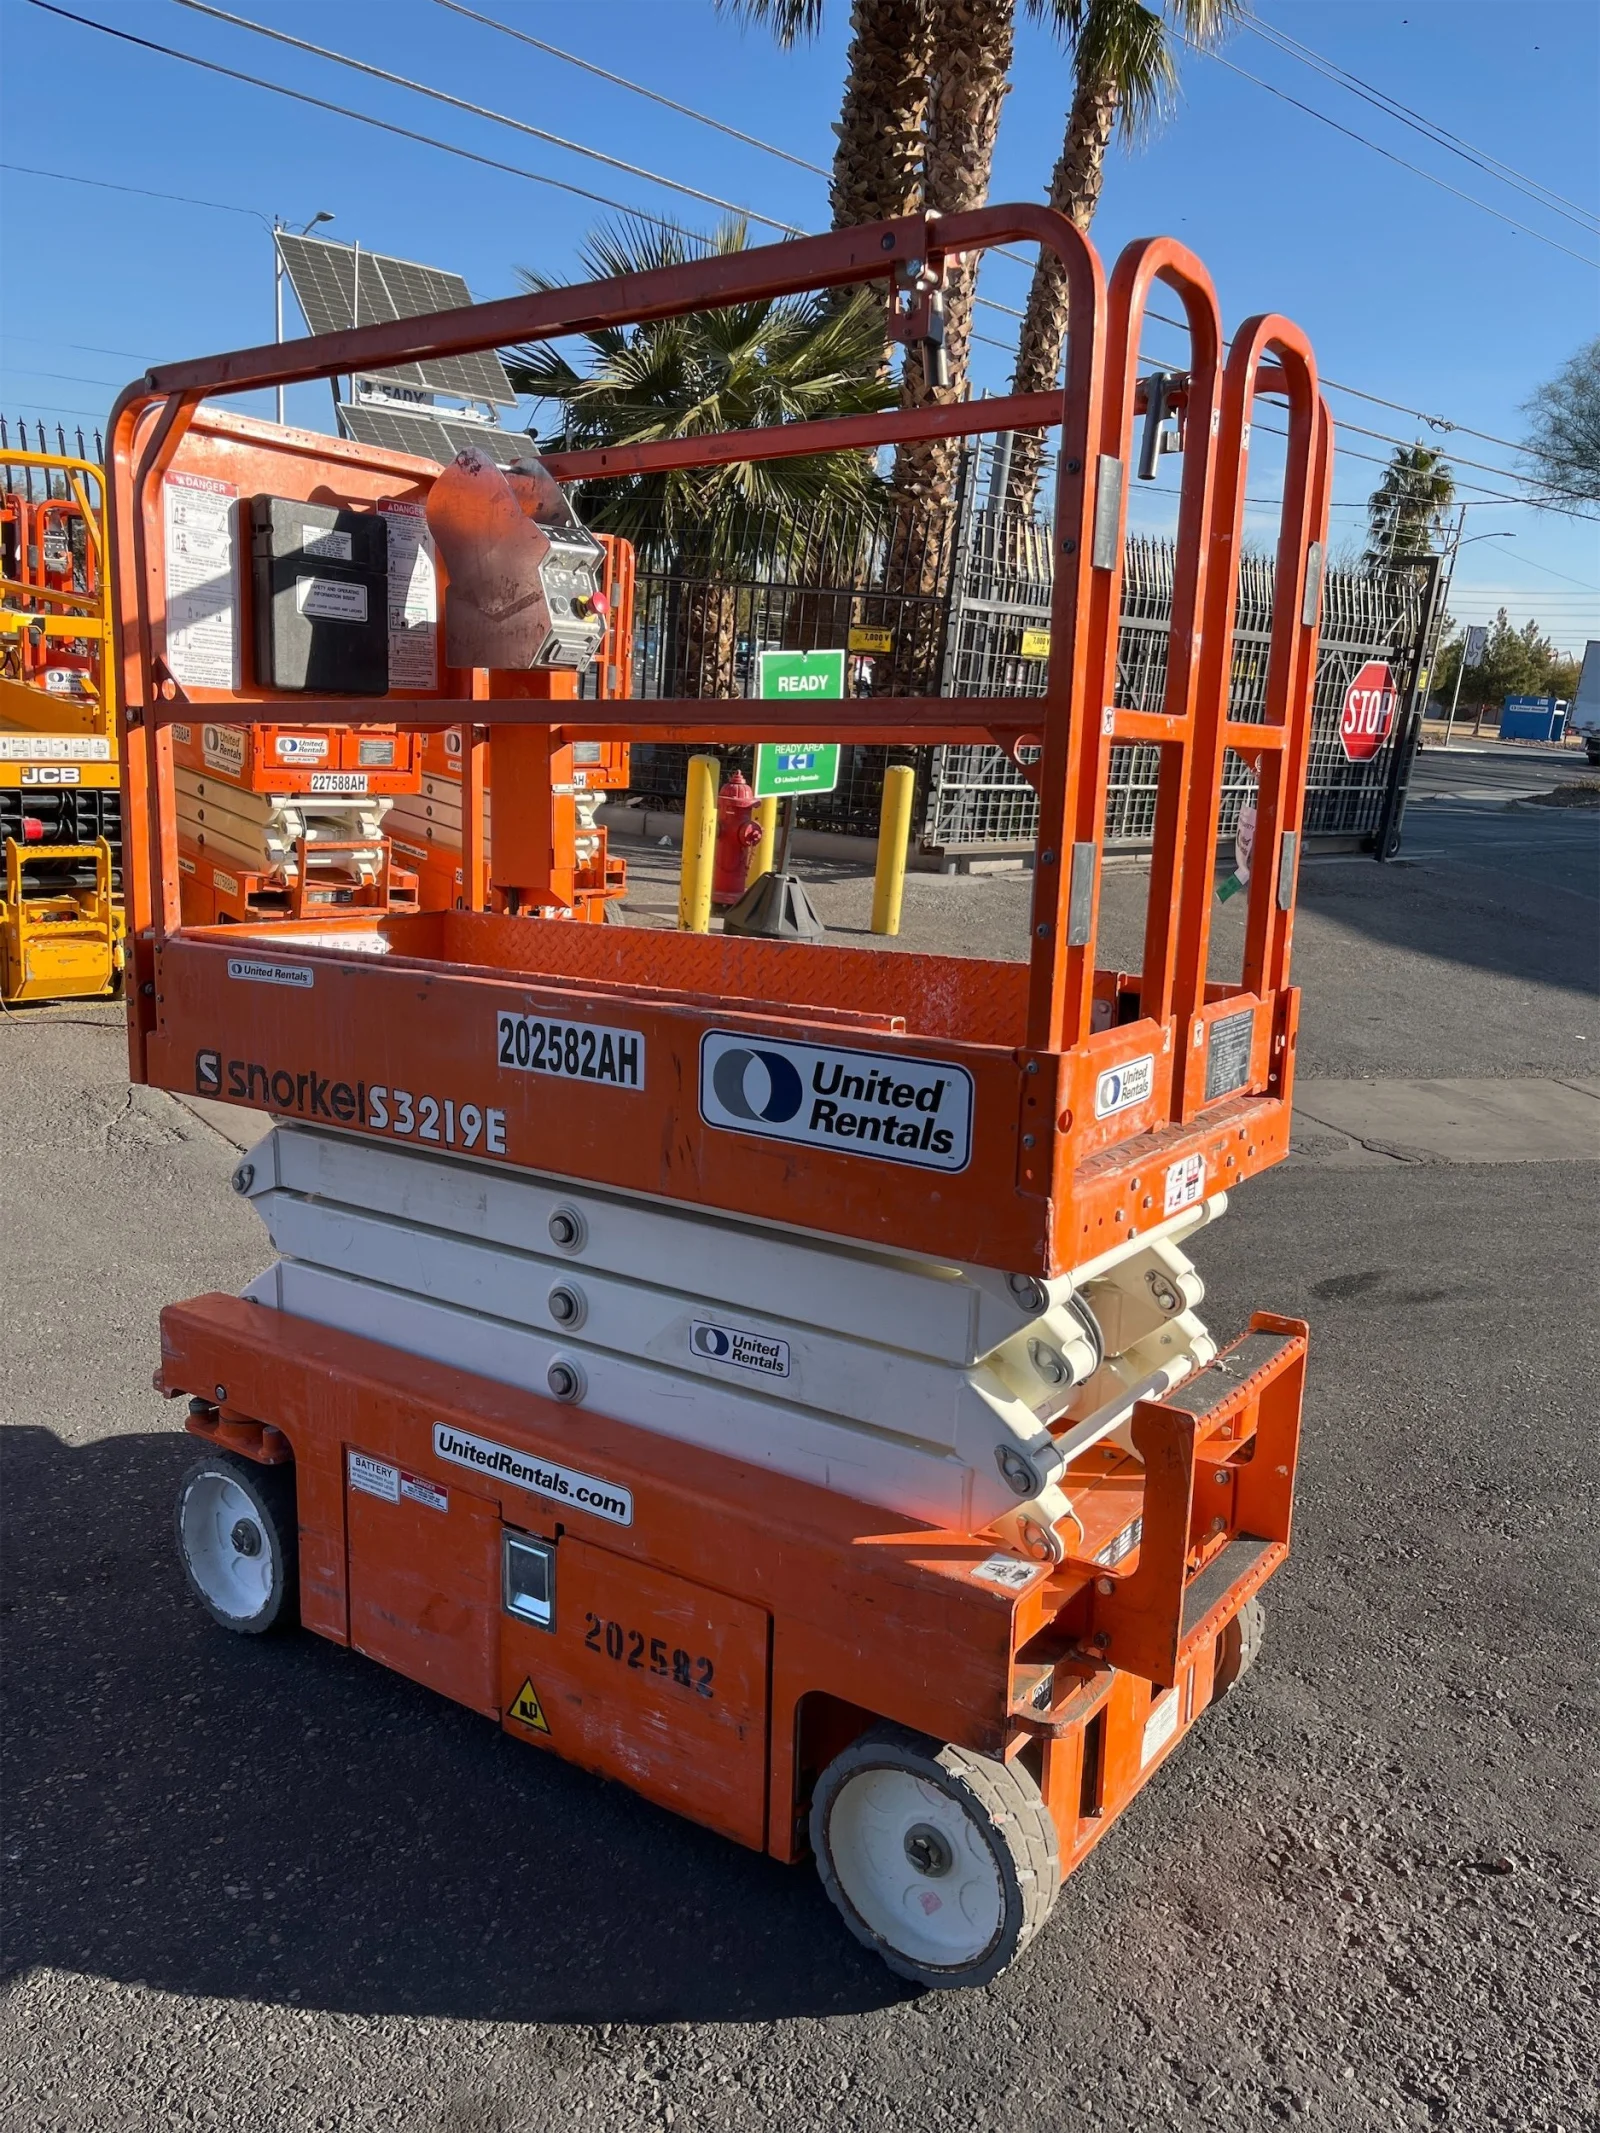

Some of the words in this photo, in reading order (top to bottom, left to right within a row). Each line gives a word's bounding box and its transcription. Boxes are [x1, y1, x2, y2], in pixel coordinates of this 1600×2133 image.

[379, 385, 425, 403] EADY
[186, 477, 226, 493] DANGER
[394, 503, 425, 515] DANGER
[778, 674, 829, 693] READY
[1344, 689, 1393, 734] STOP
[219, 730, 240, 748] United
[298, 739, 323, 748] United
[775, 744, 802, 754] READY
[219, 743, 242, 760] Rentals
[298, 746, 326, 754] Rentals
[22, 768, 80, 783] JCB
[312, 775, 366, 791] 227588AH
[244, 964, 273, 977] United
[274, 968, 308, 982] Rentals
[500, 1017, 637, 1085] 202582AH
[1122, 1063, 1149, 1086] United
[812, 1061, 945, 1113] United
[1120, 1078, 1149, 1102] Rentals
[227, 1060, 366, 1125] snorkel
[368, 1084, 507, 1155] S3219E
[809, 1098, 955, 1154] Rentals
[732, 1335, 780, 1358] United
[731, 1347, 785, 1372] Rentals
[355, 1457, 393, 1479] BATTERY
[438, 1431, 626, 1517] UnitedRentals.com
[584, 1612, 714, 1698] 202582
